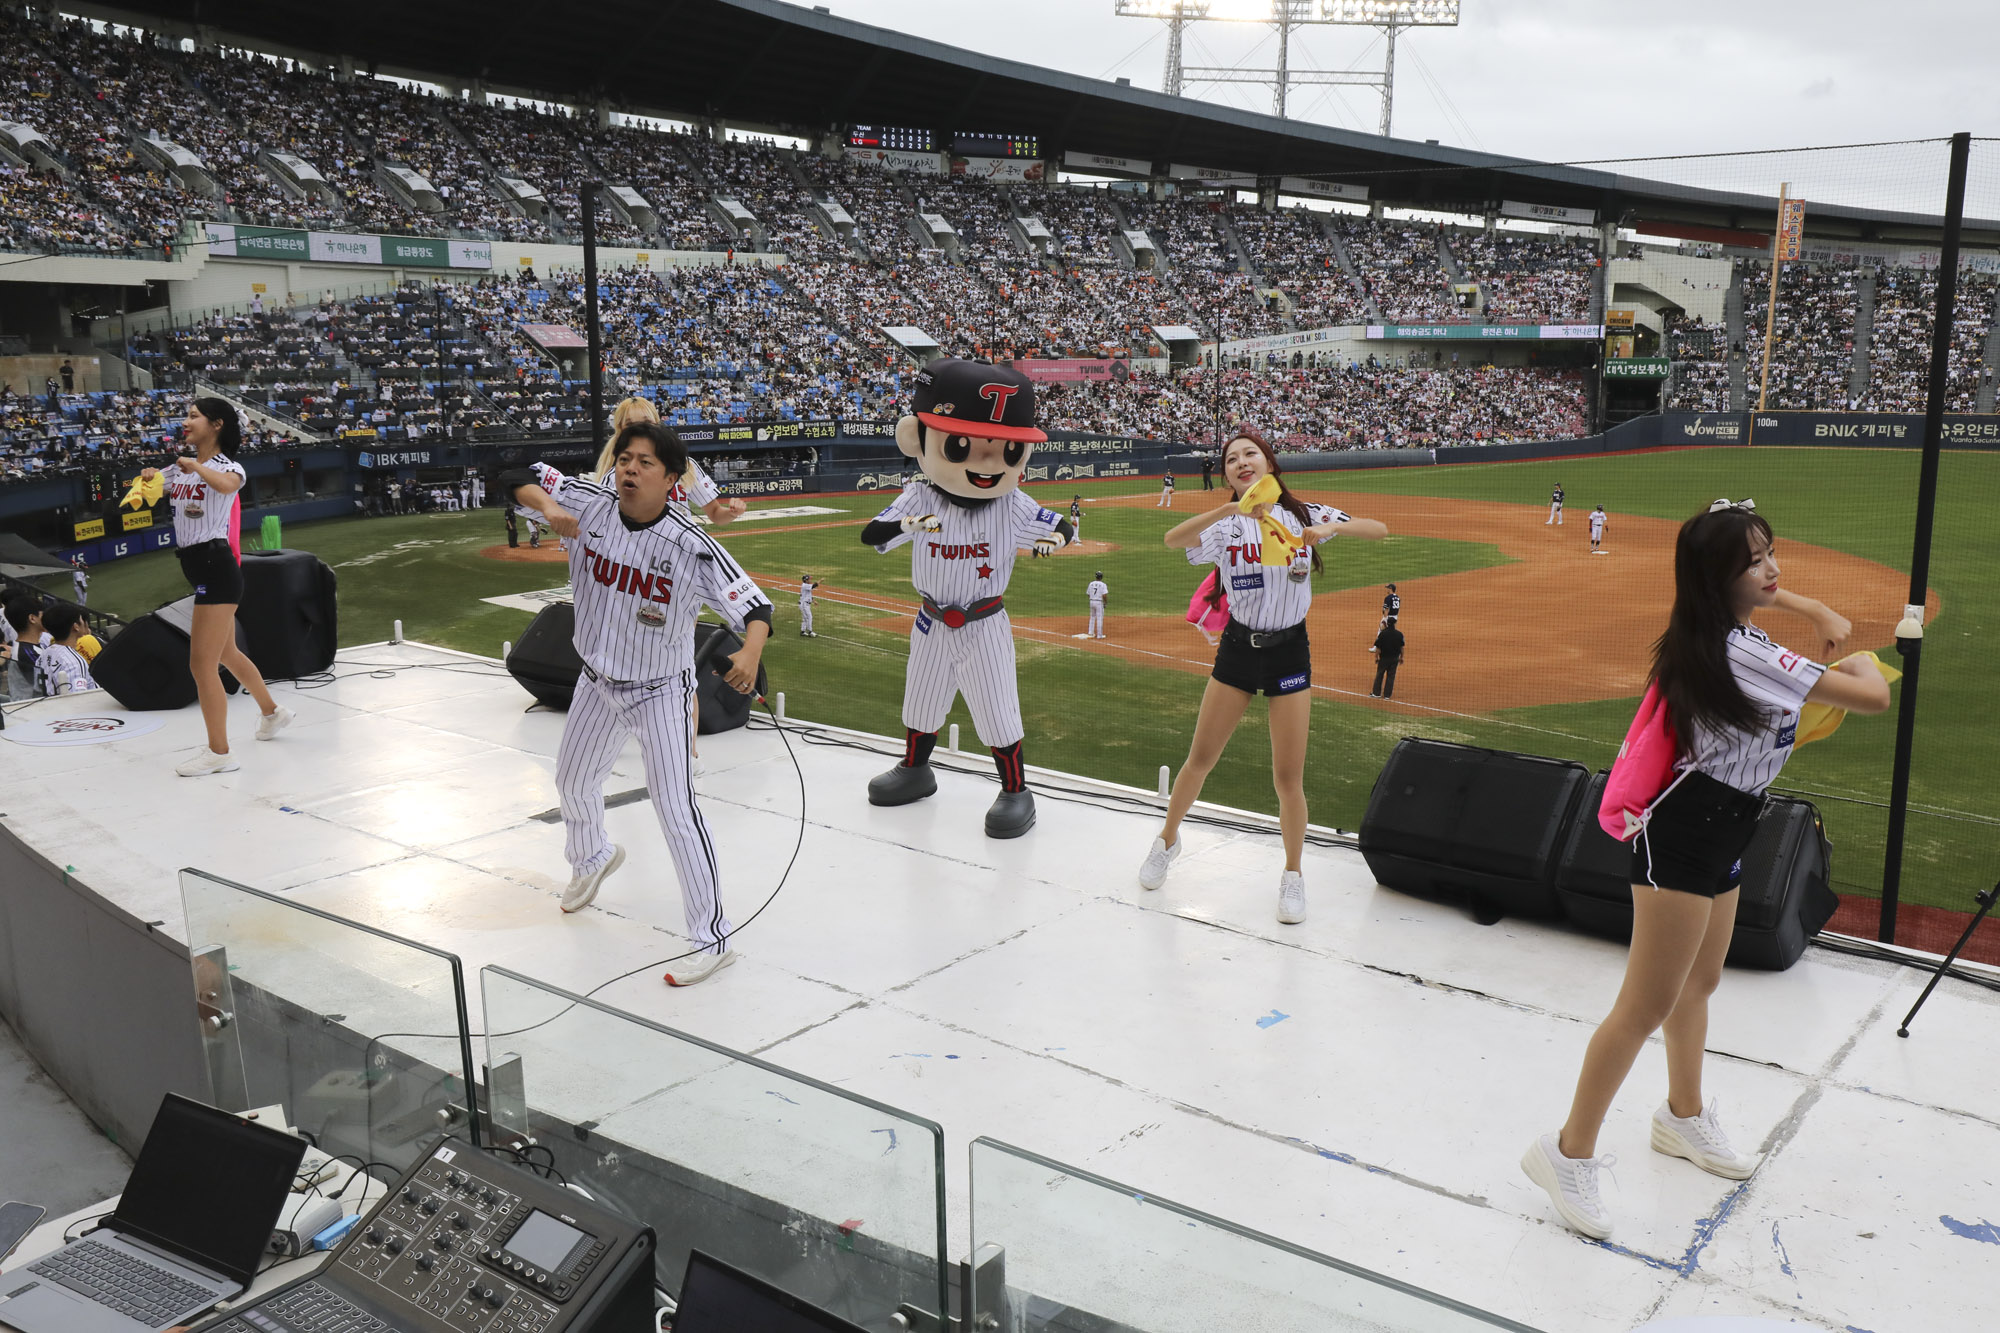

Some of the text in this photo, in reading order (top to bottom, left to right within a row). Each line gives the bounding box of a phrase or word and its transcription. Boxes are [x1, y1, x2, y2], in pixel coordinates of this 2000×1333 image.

[273, 239, 305, 251] 전문은행
[337, 242, 367, 255] 하나은행
[1433, 328, 1447, 336] 하나
[1079, 366, 1105, 374] TVING
[1606, 364, 1668, 375] 대신정보통신
[1756, 418, 1778, 427] 100m
[679, 431, 714, 440] mentos
[765, 424, 799, 437] 수협보험
[804, 426, 836, 438] 수협쇼핑
[1068, 440, 1133, 455] 충남혁신도시
[1028, 467, 1048, 479] PRINGLES
[1075, 465, 1094, 478] PRINGLES
[880, 474, 901, 487] PRINGLES
[158, 533, 170, 546] LS
[972, 532, 985, 541] LG
[115, 543, 128, 556] LS
[928, 541, 990, 560] TWINS
[650, 555, 673, 574] LG
[584, 543, 673, 605] TWINS
[1233, 576, 1263, 588] 신한카드
[737, 584, 748, 595] LG
[1280, 675, 1306, 689] 신한카드
